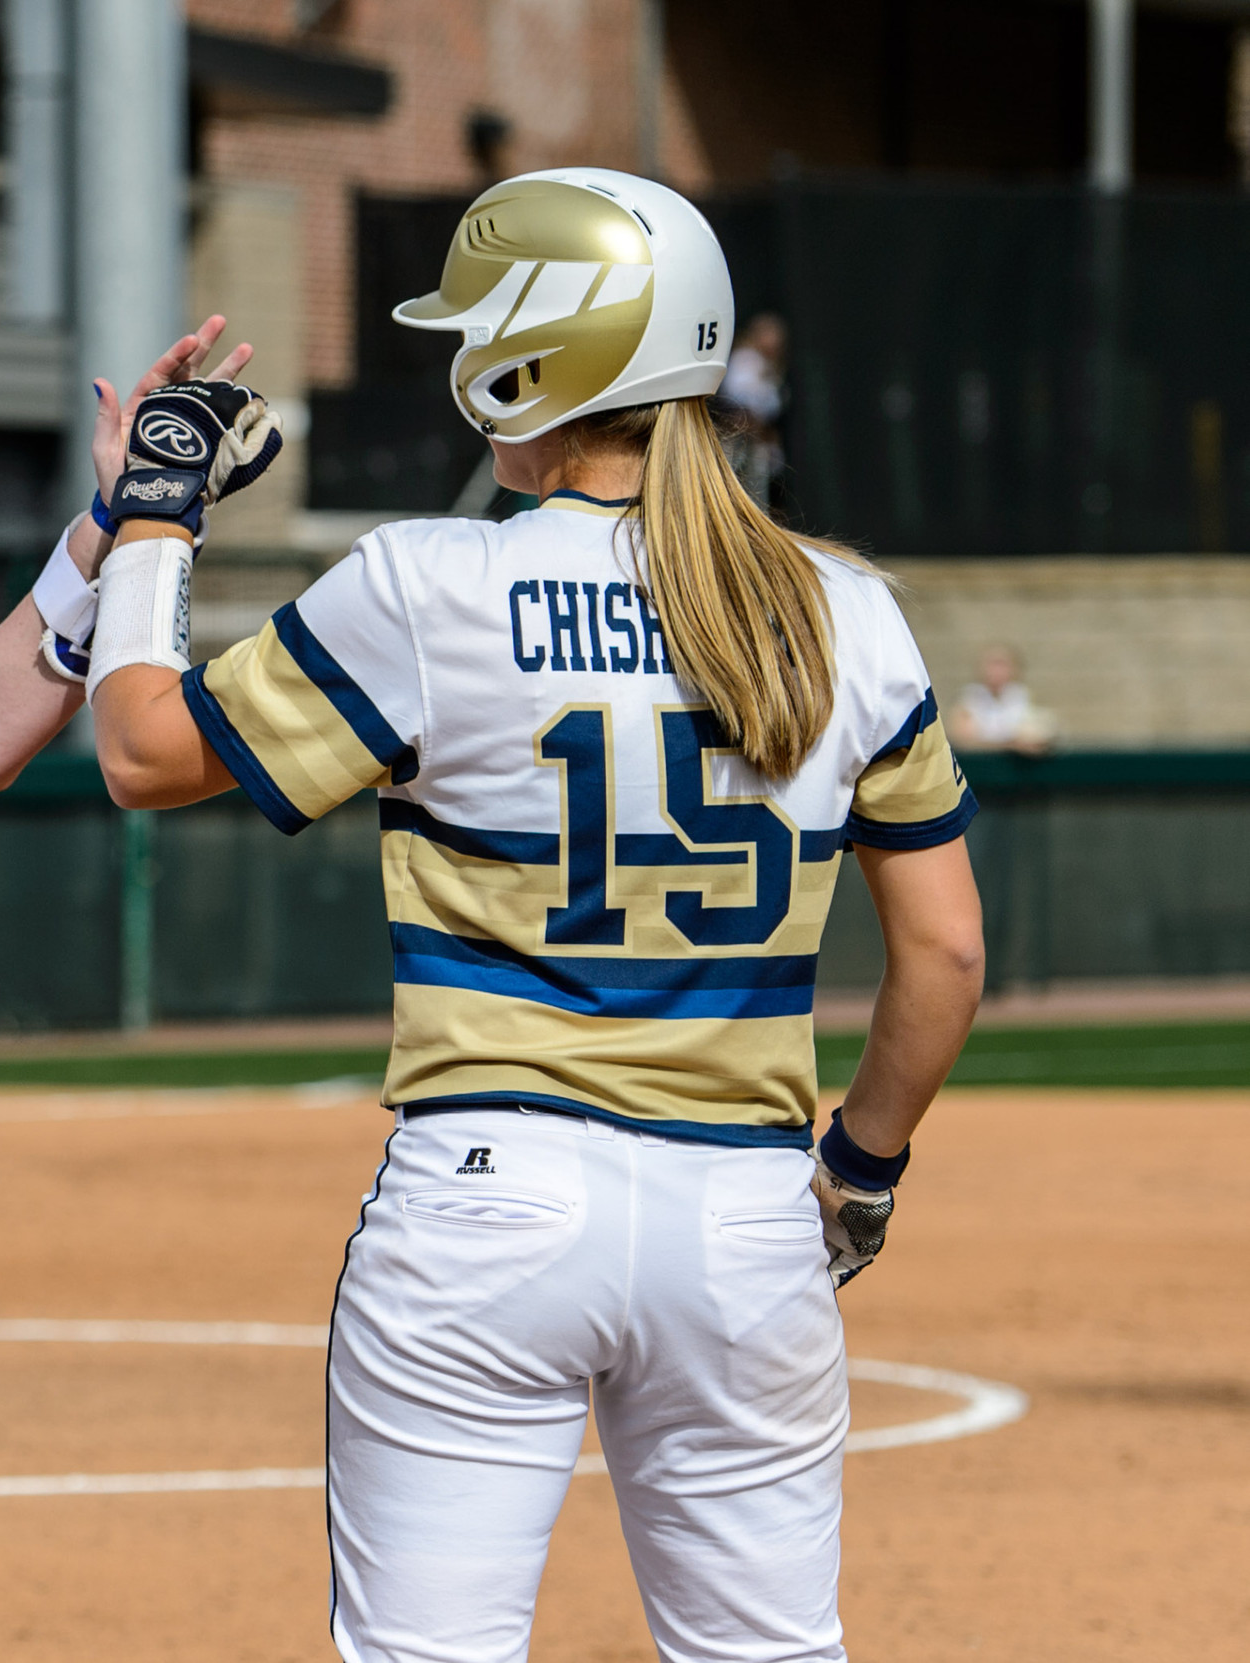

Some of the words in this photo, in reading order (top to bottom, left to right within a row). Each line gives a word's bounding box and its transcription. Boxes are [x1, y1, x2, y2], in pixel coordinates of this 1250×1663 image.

[697, 321, 718, 351] 15
[121, 477, 186, 500] Rawlings
[532, 702, 801, 954] 15
[464, 1147, 492, 1166] R
[455, 1165, 496, 1175] RUSSELL
